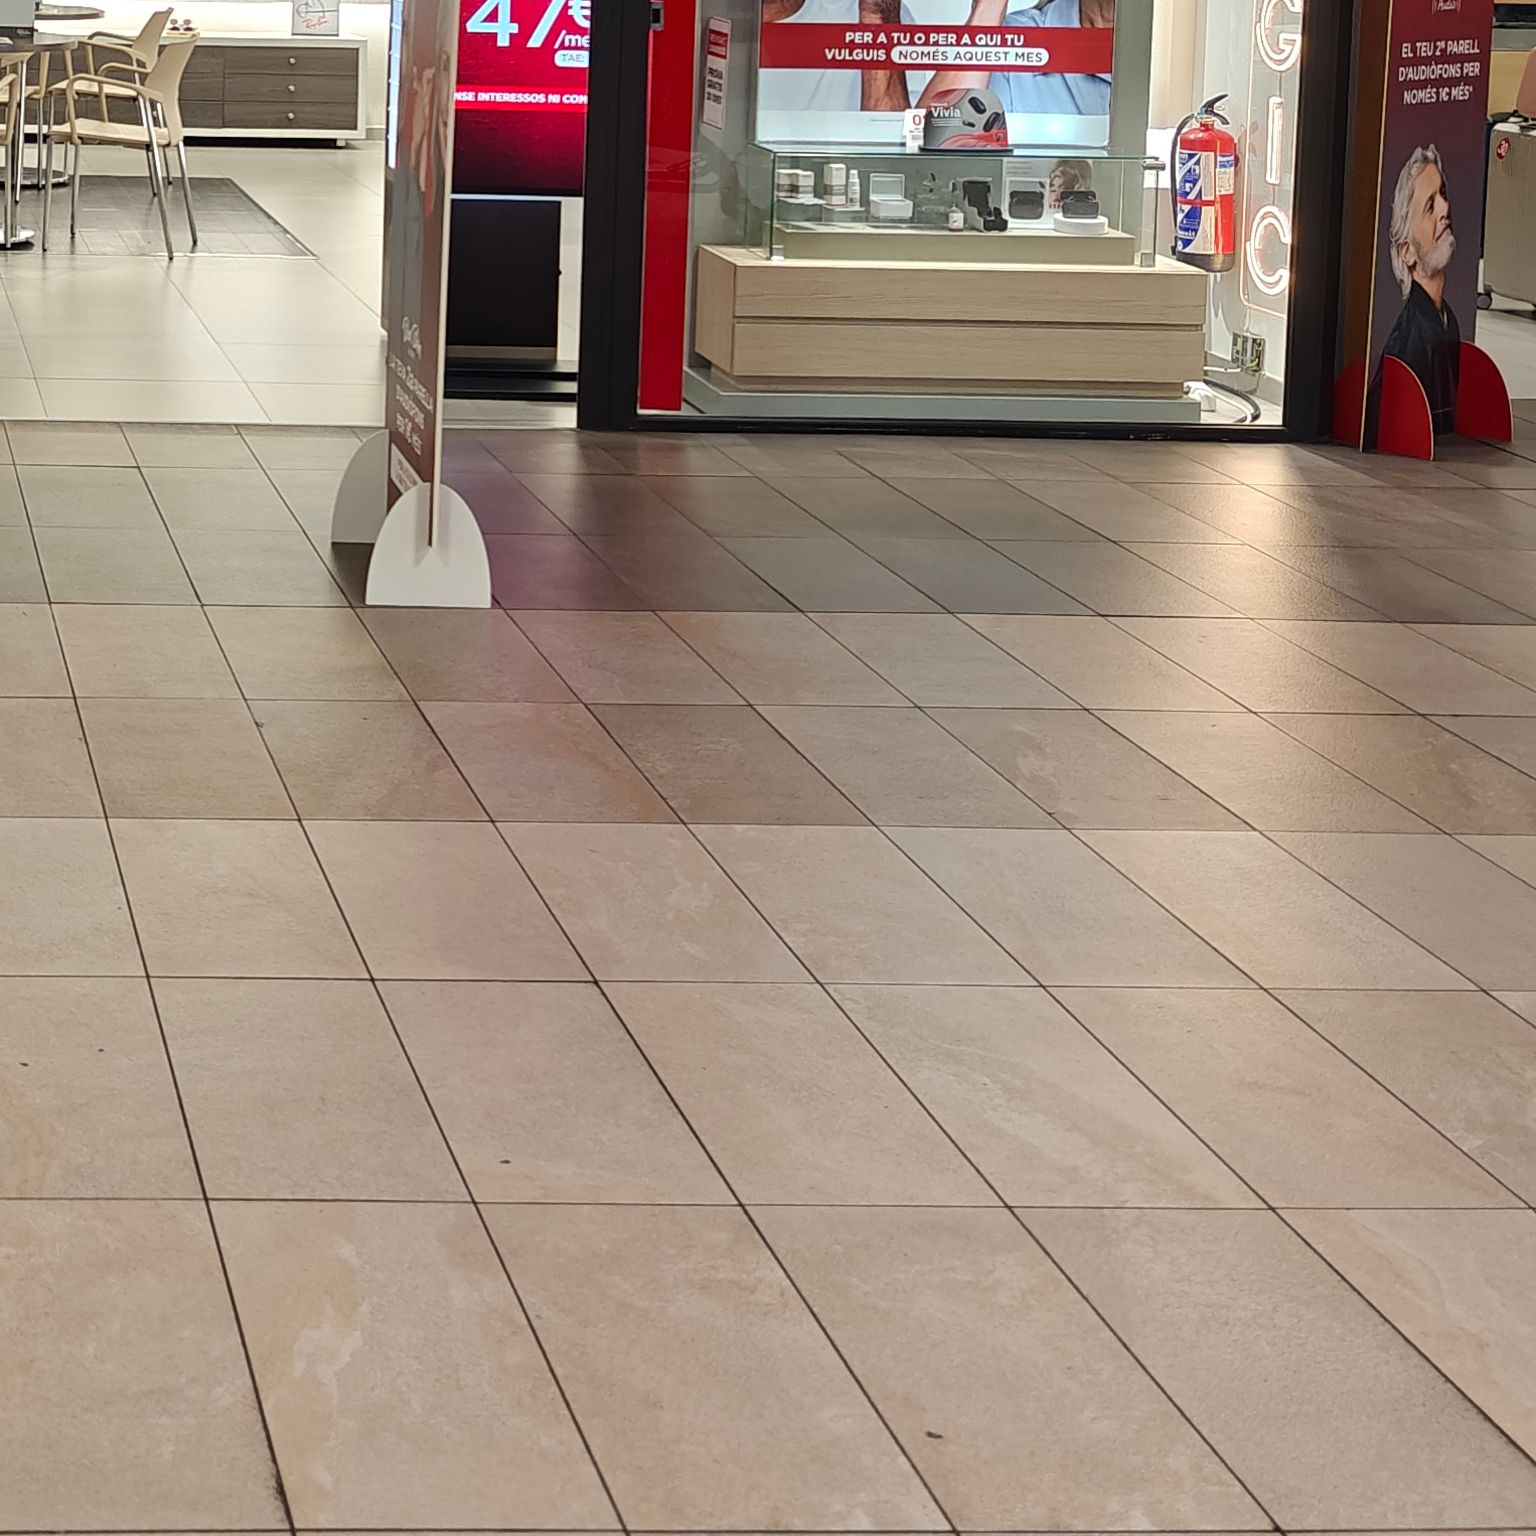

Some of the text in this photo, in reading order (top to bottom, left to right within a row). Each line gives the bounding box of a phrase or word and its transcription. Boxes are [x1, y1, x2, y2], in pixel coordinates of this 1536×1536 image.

[845, 31, 1025, 46] PER A TU O PER A QUI TU
[824, 47, 1043, 63] VULGUIS NOMÉS AQUEST MES
[1401, 43, 1414, 58] EL
[1415, 41, 1434, 57] TEU
[1446, 39, 1481, 55] PARELL
[1398, 61, 1481, 82] D'AUDIÒFONS PER
[477, 92, 547, 103] INTERESSOS
[1403, 84, 1437, 105] NOMÉS
[930, 106, 962, 118] Vivia
